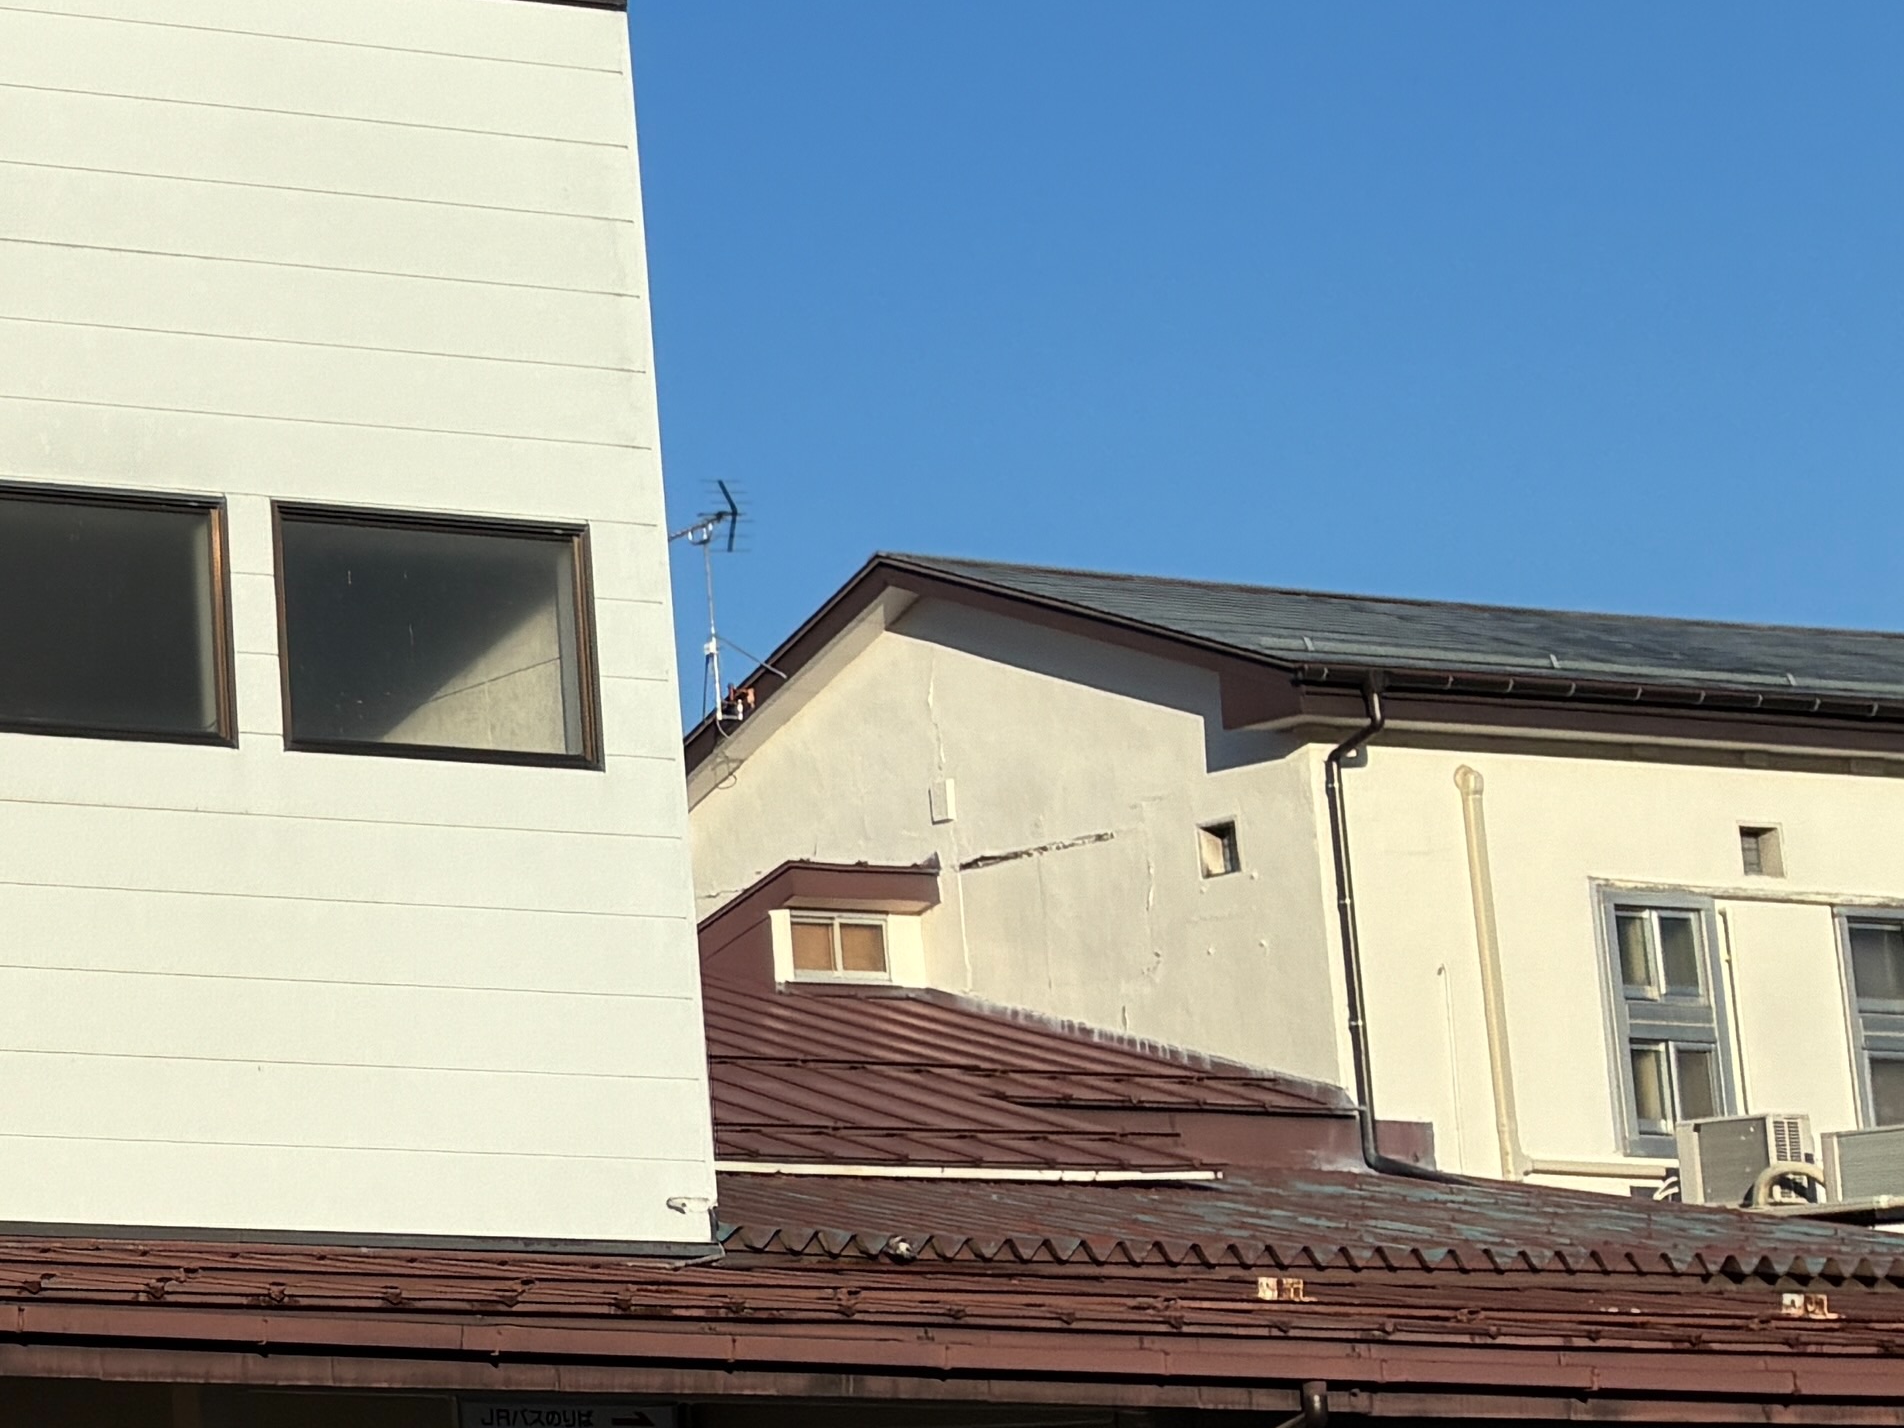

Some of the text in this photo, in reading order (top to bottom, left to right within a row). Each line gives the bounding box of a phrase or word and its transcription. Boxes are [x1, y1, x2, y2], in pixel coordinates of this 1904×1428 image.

[481, 1408, 594, 1428] JRバスのりば
